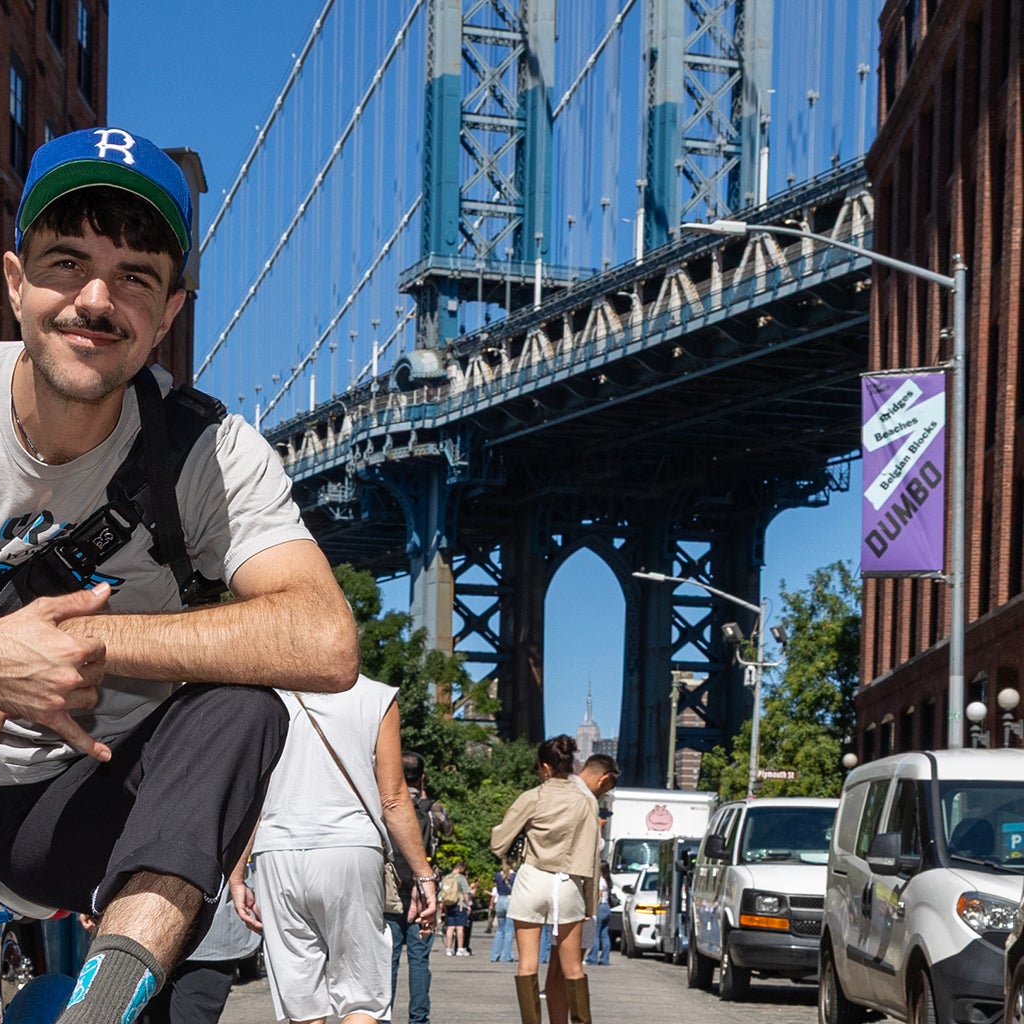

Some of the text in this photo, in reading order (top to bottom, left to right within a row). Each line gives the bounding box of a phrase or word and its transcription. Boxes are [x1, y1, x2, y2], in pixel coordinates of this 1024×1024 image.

[93, 129, 136, 165] R
[873, 416, 919, 442] Beaches
[879, 420, 939, 491] Belgian Blocks
[864, 460, 943, 559] DUMBO
[757, 770, 795, 779] Plymouth St
[1011, 833, 1023, 849] P
